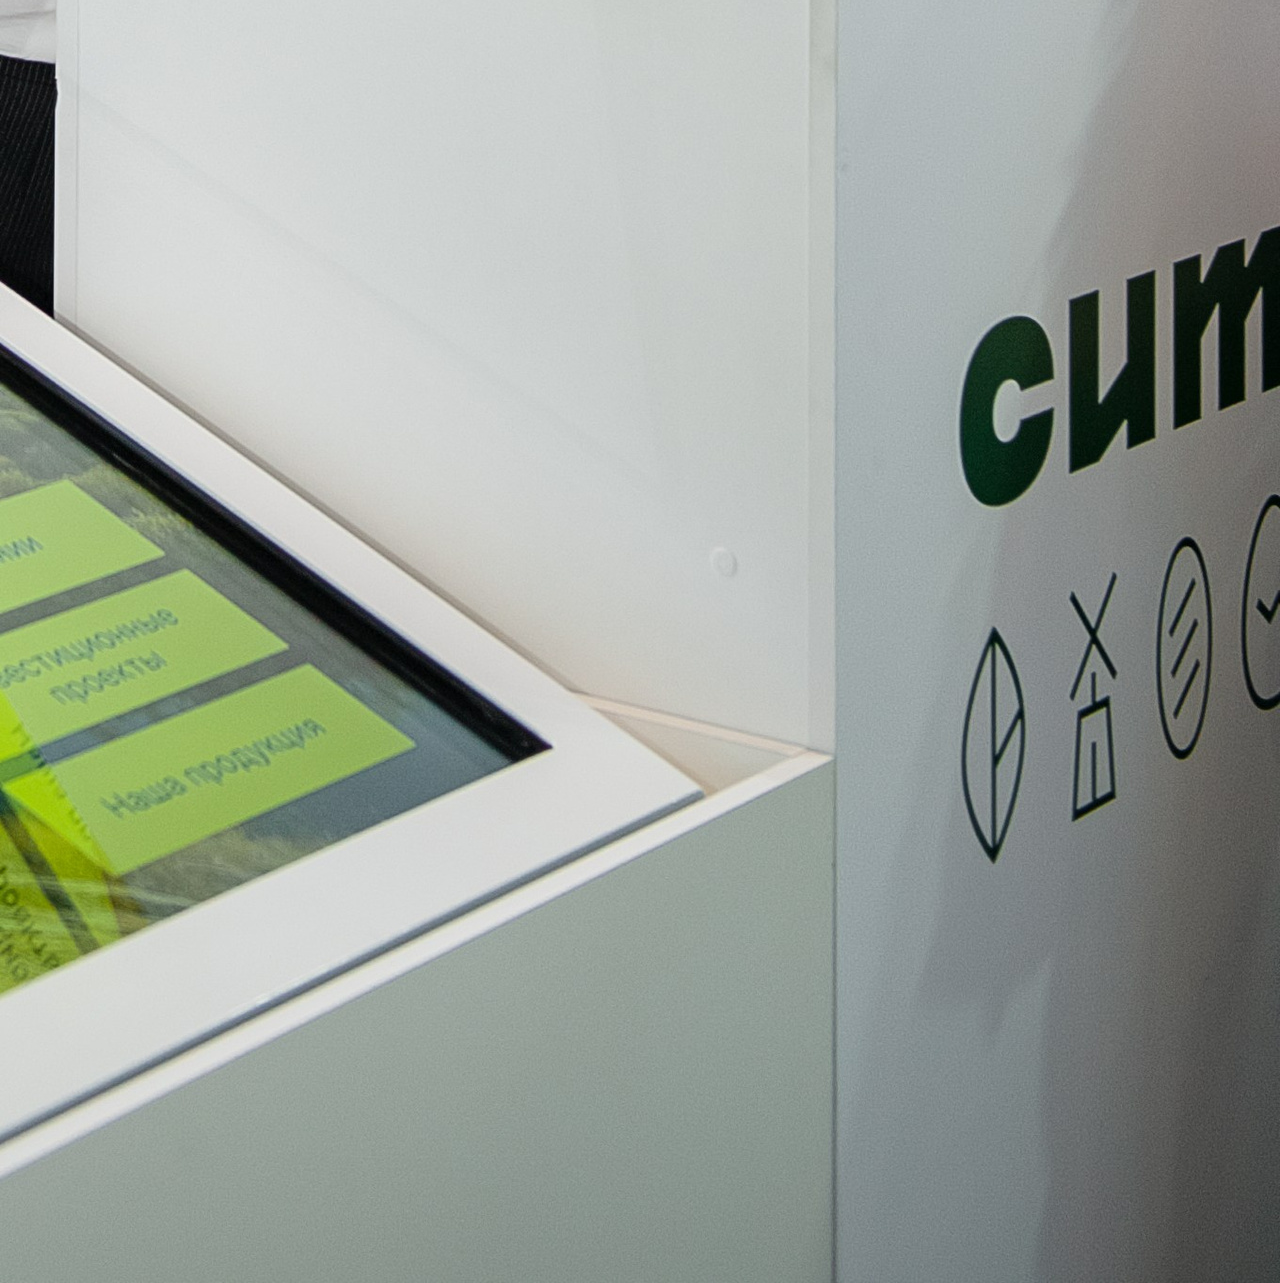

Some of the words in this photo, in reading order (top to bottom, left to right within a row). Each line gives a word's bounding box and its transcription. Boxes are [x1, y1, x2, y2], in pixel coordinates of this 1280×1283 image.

[959, 225, 1280, 507] сит
[48, 647, 169, 707] проекты
[101, 769, 188, 821] Наша
[185, 716, 328, 792] продукция
